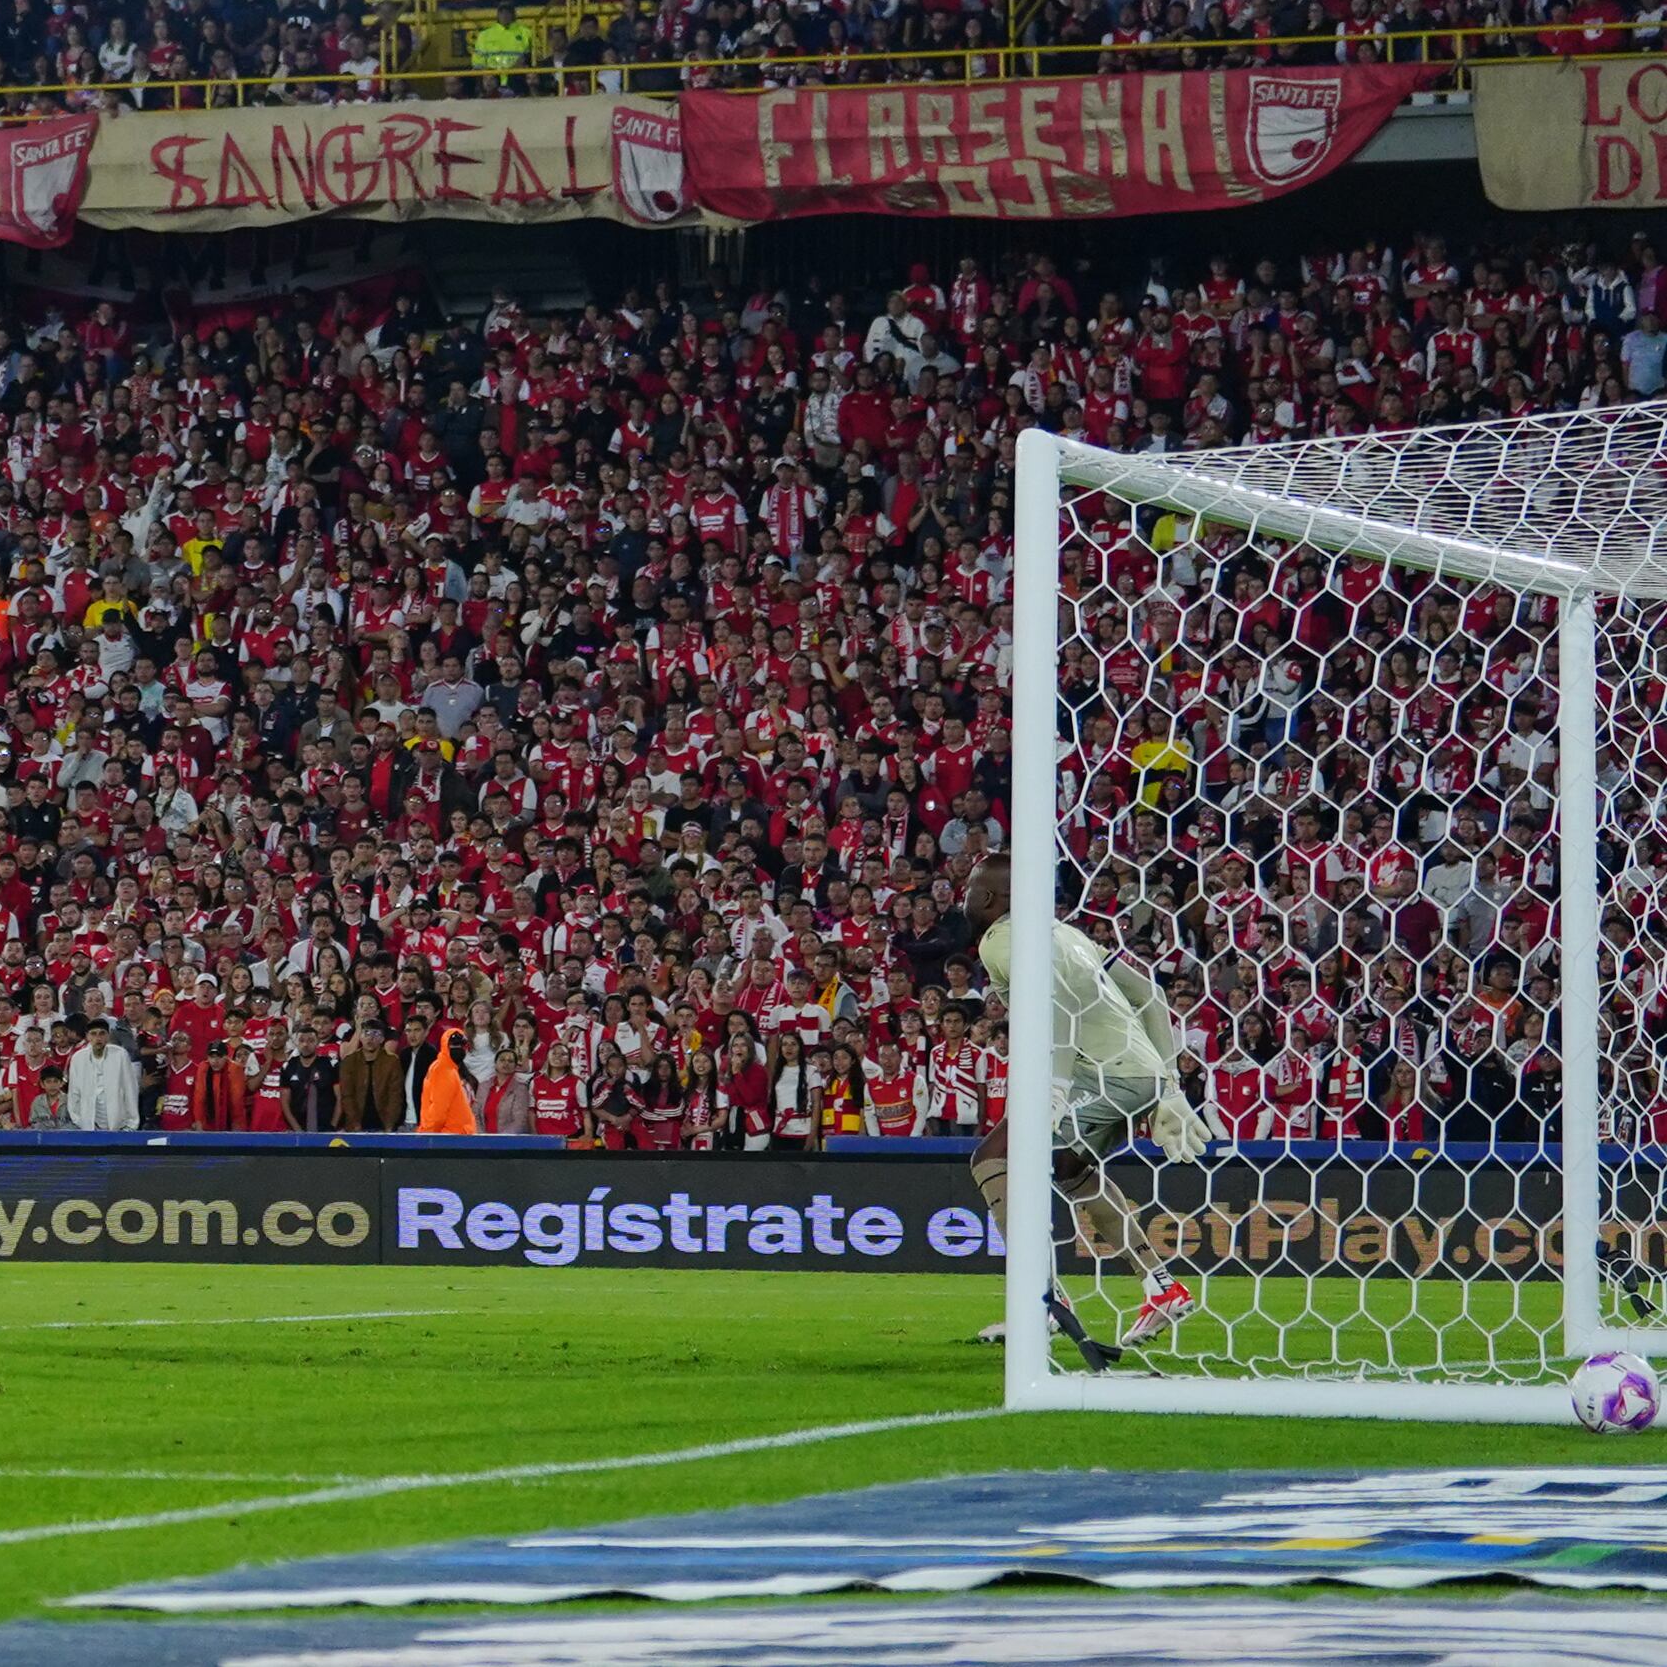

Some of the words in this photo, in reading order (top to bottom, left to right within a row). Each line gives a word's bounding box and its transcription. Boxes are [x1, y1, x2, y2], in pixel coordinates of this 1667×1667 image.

[1254, 83, 1307, 104] SANTA
[1312, 90, 1336, 106] FE
[613, 114, 661, 141] SANTA
[868, 72, 1264, 200] ARSENAL
[16, 138, 59, 163] SANTA
[63, 132, 86, 151] FE
[397, 1187, 904, 1266] Regístrate
